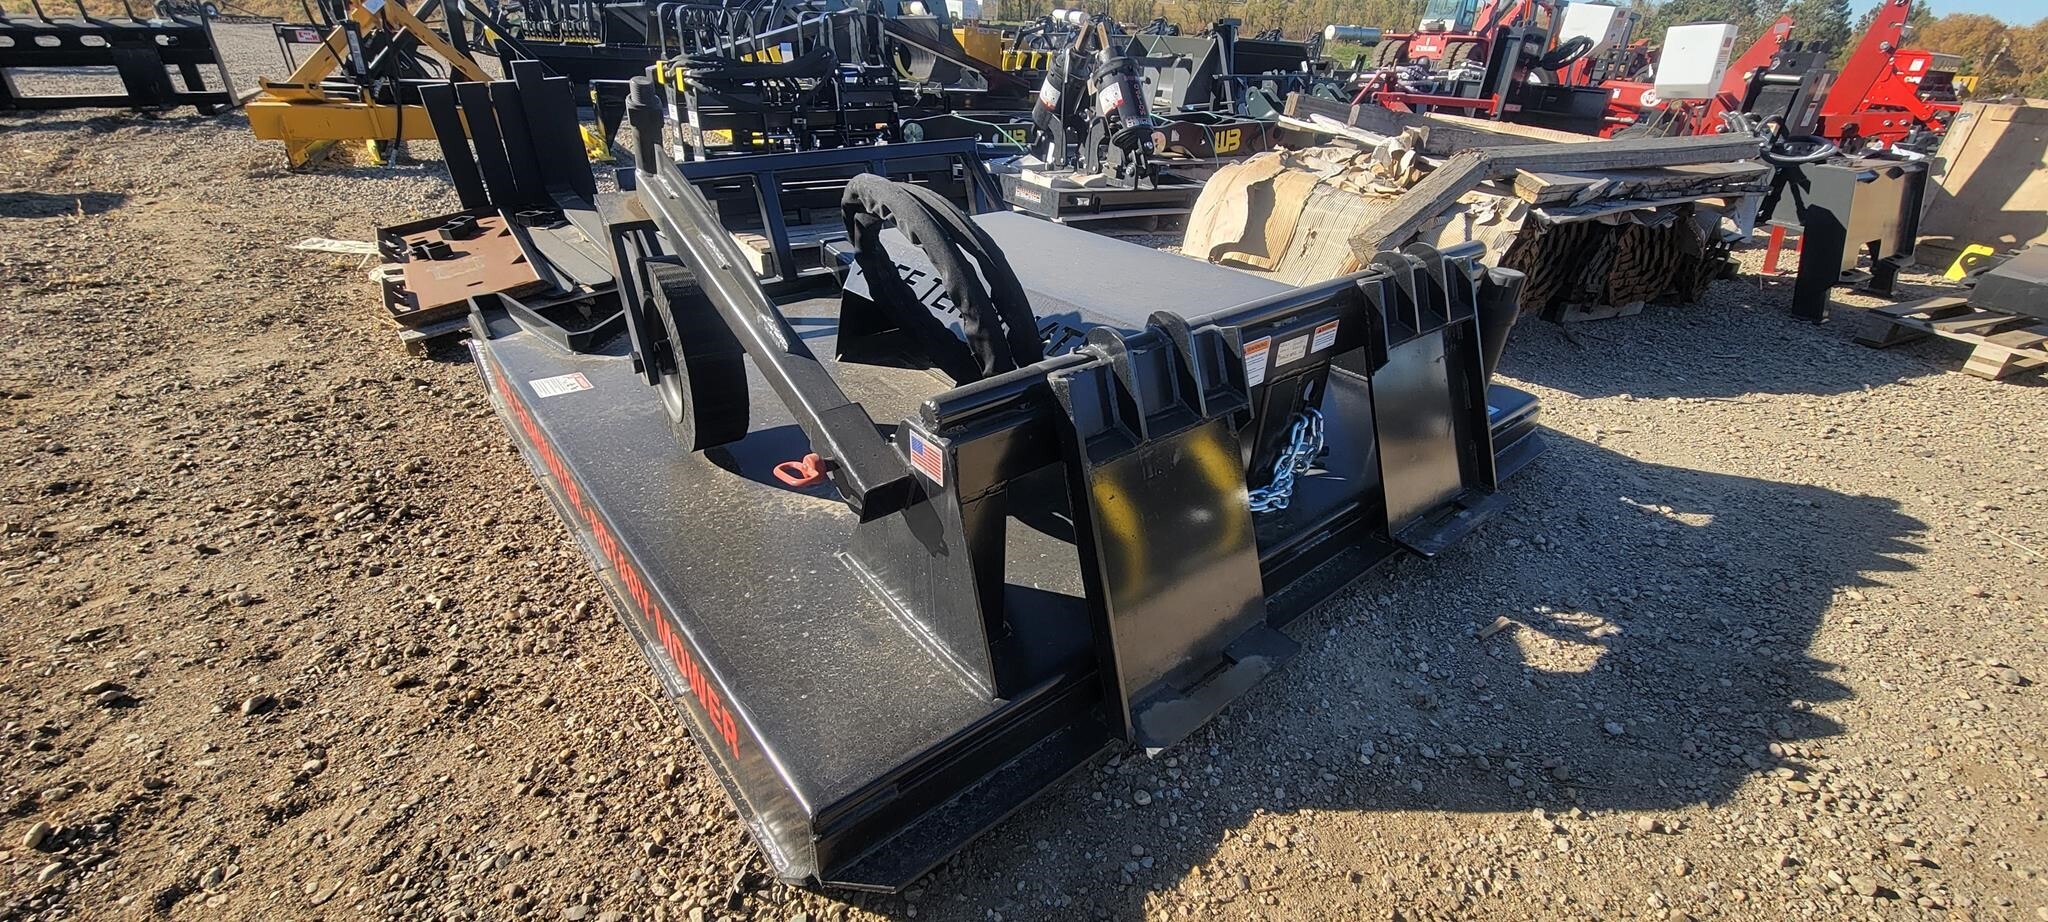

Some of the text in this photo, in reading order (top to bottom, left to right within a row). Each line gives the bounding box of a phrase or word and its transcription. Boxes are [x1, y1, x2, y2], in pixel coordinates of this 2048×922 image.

[1215, 128, 1242, 154] WB
[588, 506, 650, 621] ROTARY
[654, 603, 740, 761] MOWER
